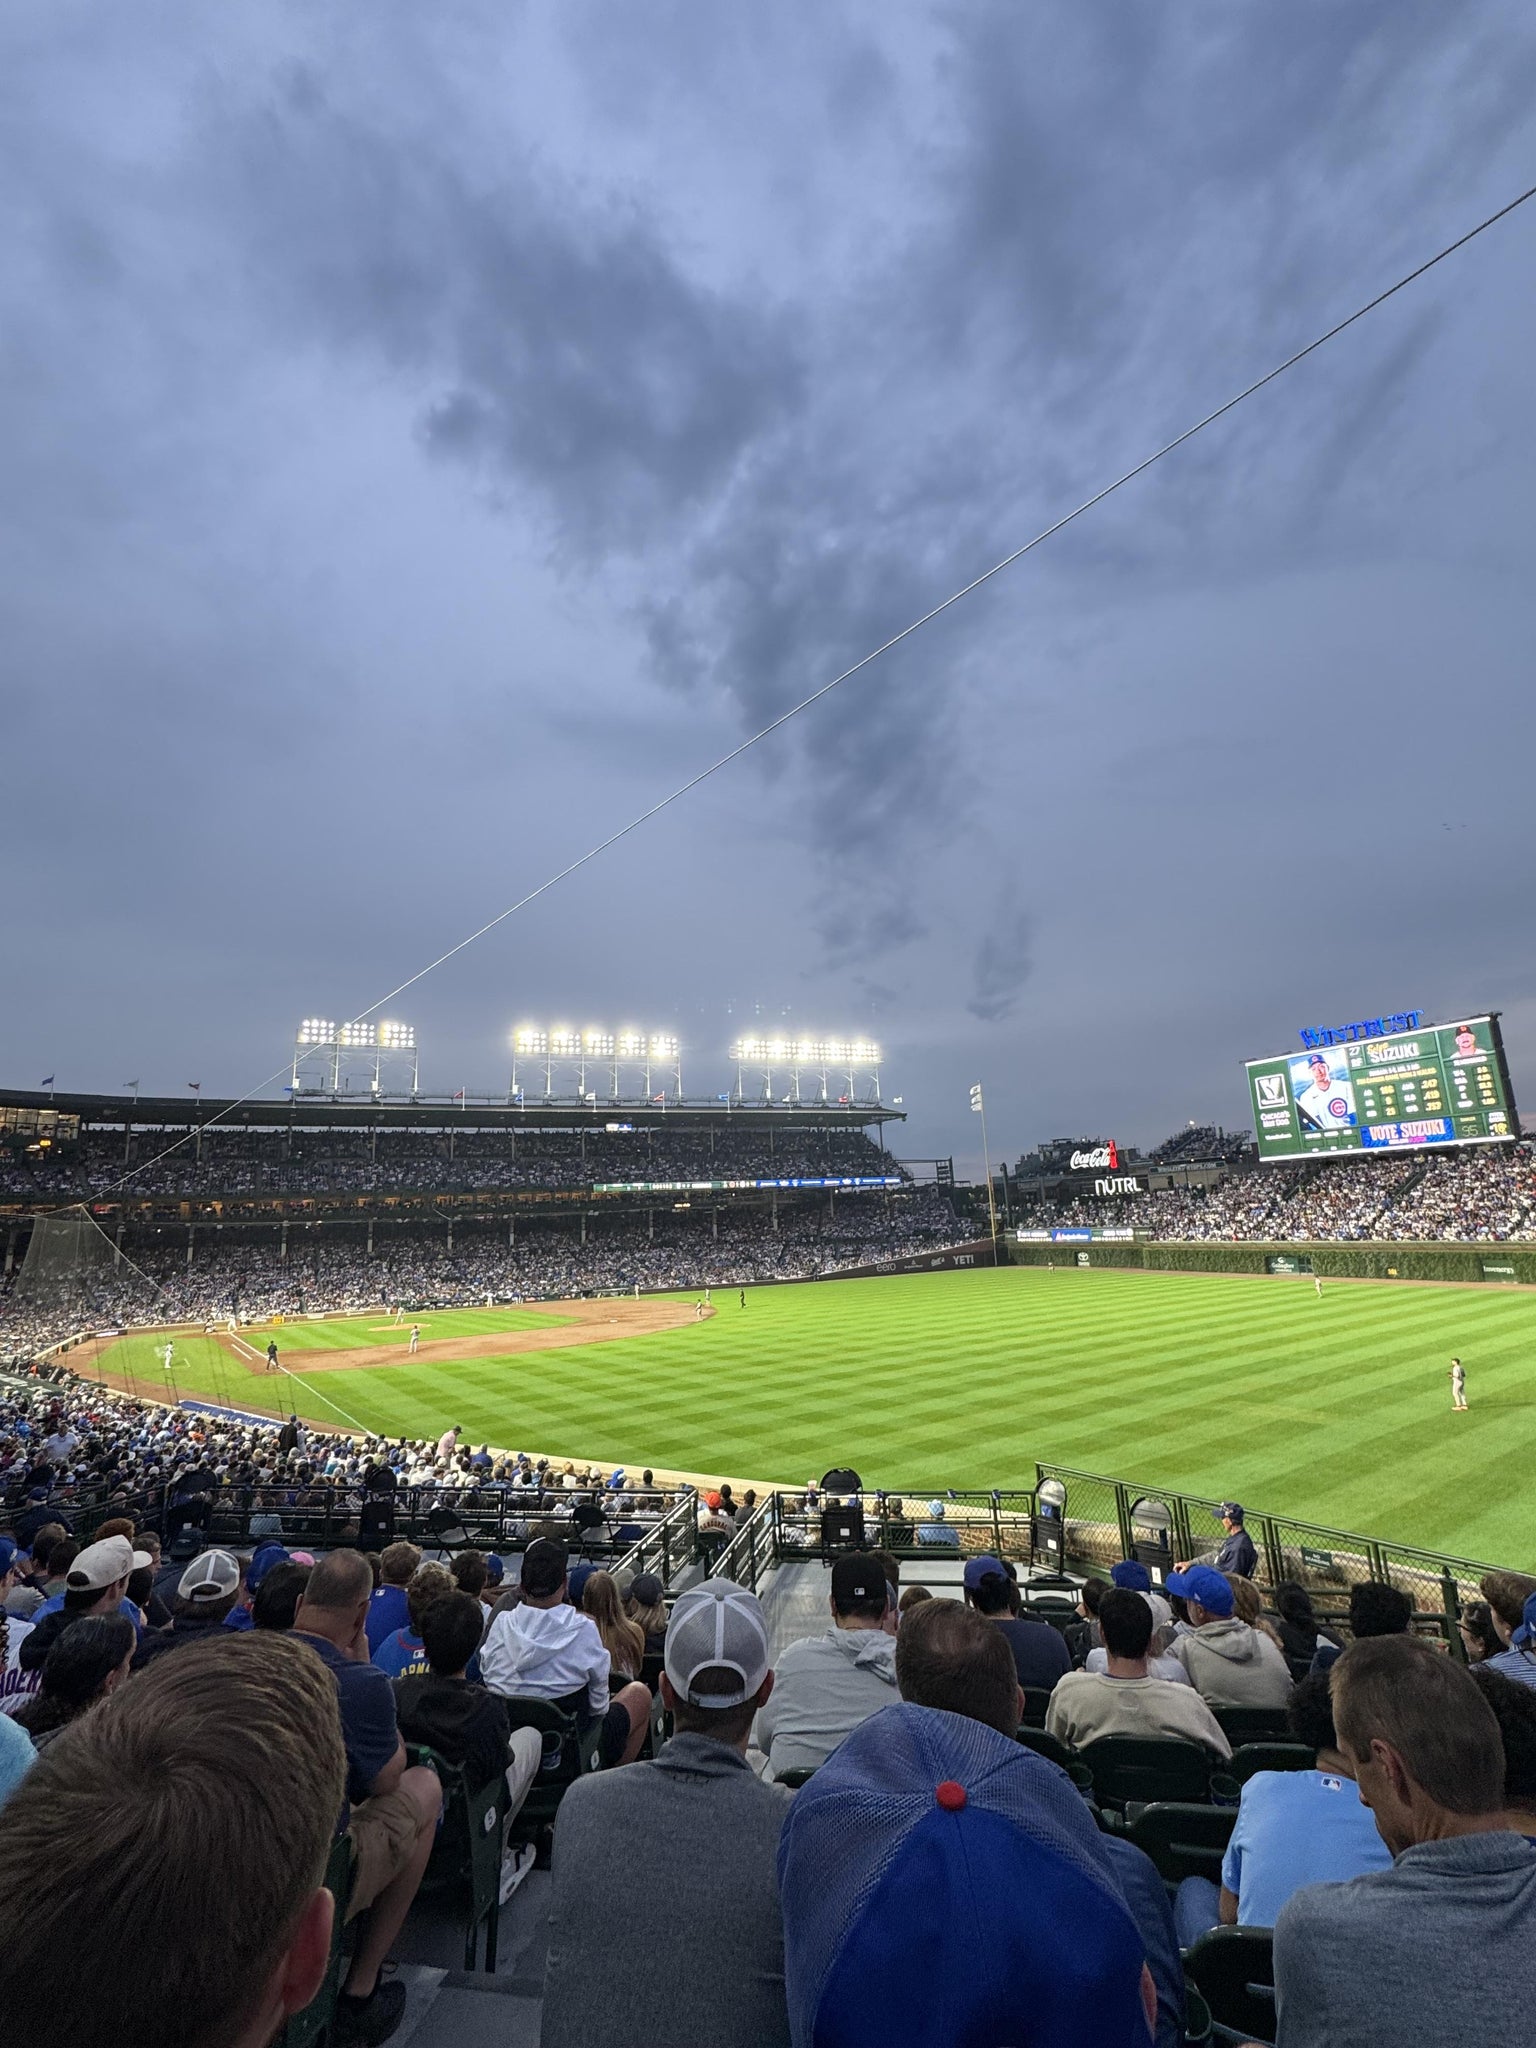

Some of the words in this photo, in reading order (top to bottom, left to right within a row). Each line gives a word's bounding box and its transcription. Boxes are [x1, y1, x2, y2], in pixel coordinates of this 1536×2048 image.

[1299, 1009, 1425, 1049] WINTRUST
[1349, 1046, 1360, 1056] 27
[1370, 1042, 1420, 1063] SUZUKI
[1369, 1123, 1399, 1141] VOTE
[1400, 1118, 1446, 1138] SUZUKI
[876, 1262, 897, 1272] eero
[953, 1254, 975, 1265] YETI
